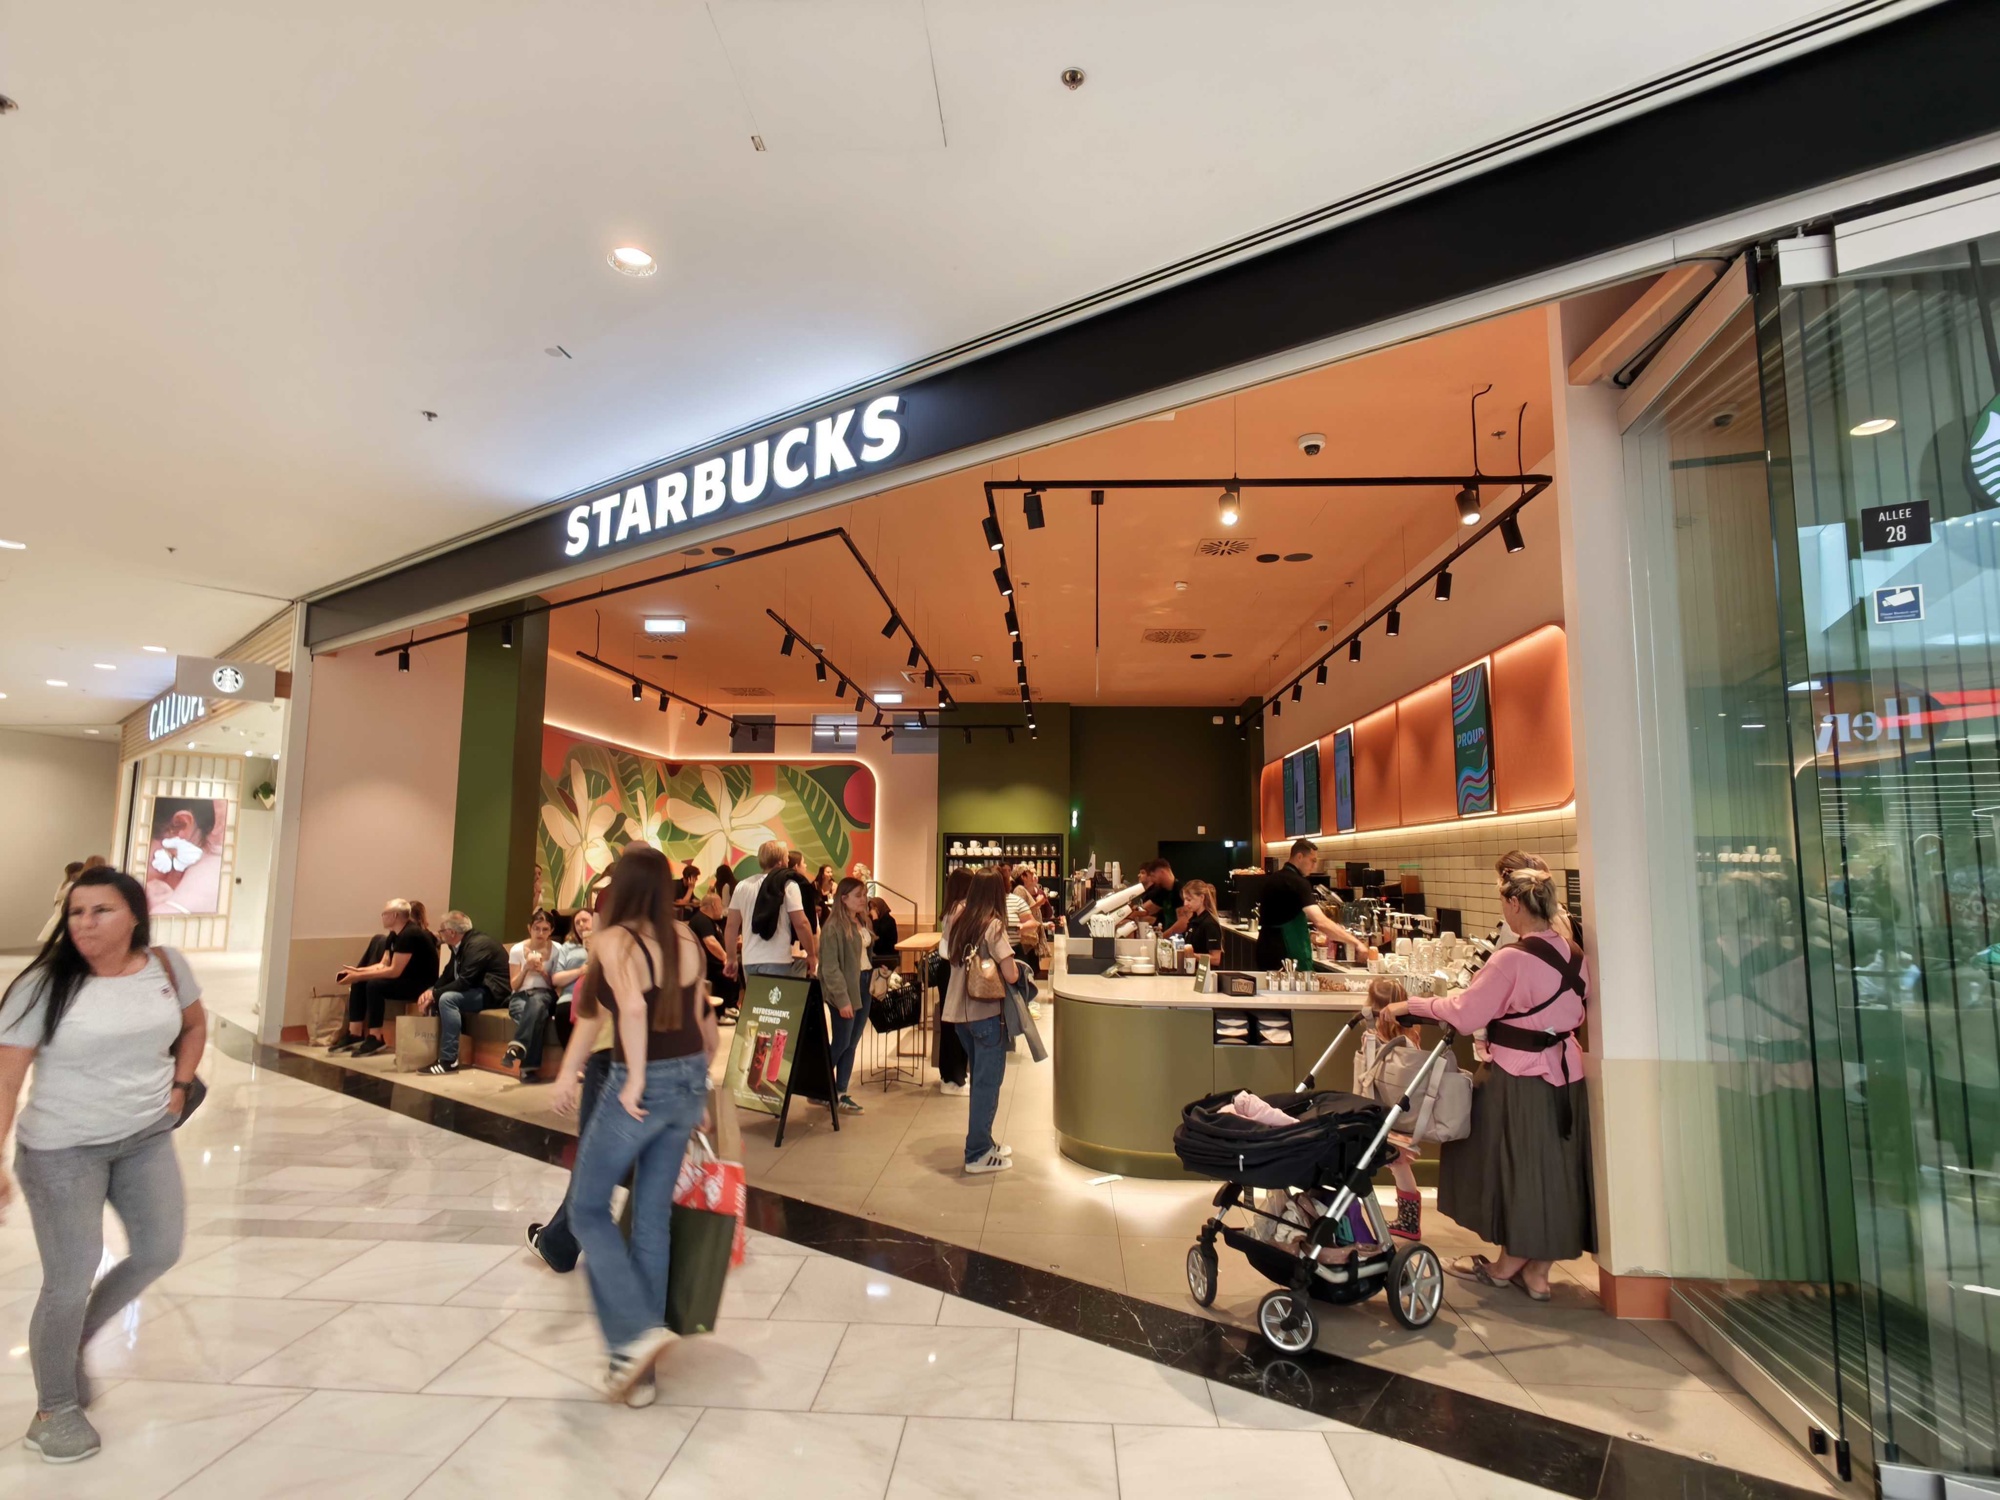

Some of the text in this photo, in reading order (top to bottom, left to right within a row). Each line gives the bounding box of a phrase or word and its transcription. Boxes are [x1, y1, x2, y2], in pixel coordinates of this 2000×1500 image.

[563, 395, 903, 557] STARBUCKS
[1878, 508, 1912, 522] ALLEE
[1886, 524, 1907, 543] 28
[1456, 727, 1485, 748] PROUD
[758, 1015, 781, 1025] REFINED
